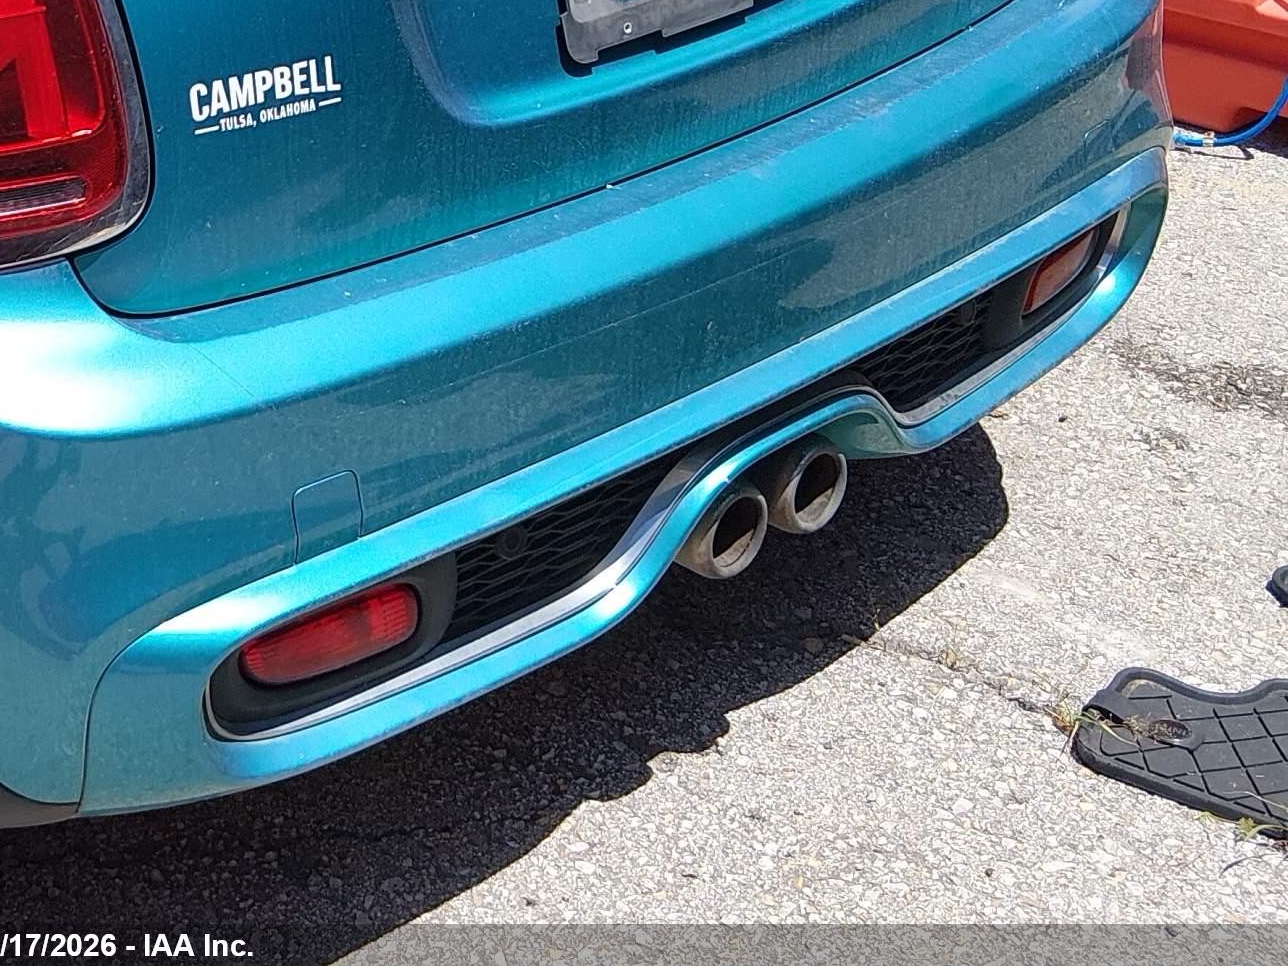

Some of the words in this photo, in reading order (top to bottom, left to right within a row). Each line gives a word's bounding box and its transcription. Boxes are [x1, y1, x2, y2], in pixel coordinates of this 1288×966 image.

[189, 55, 342, 122] CAMPBELL
[219, 116, 257, 132] TULSA,
[259, 98, 317, 123] OKLAHOMA
